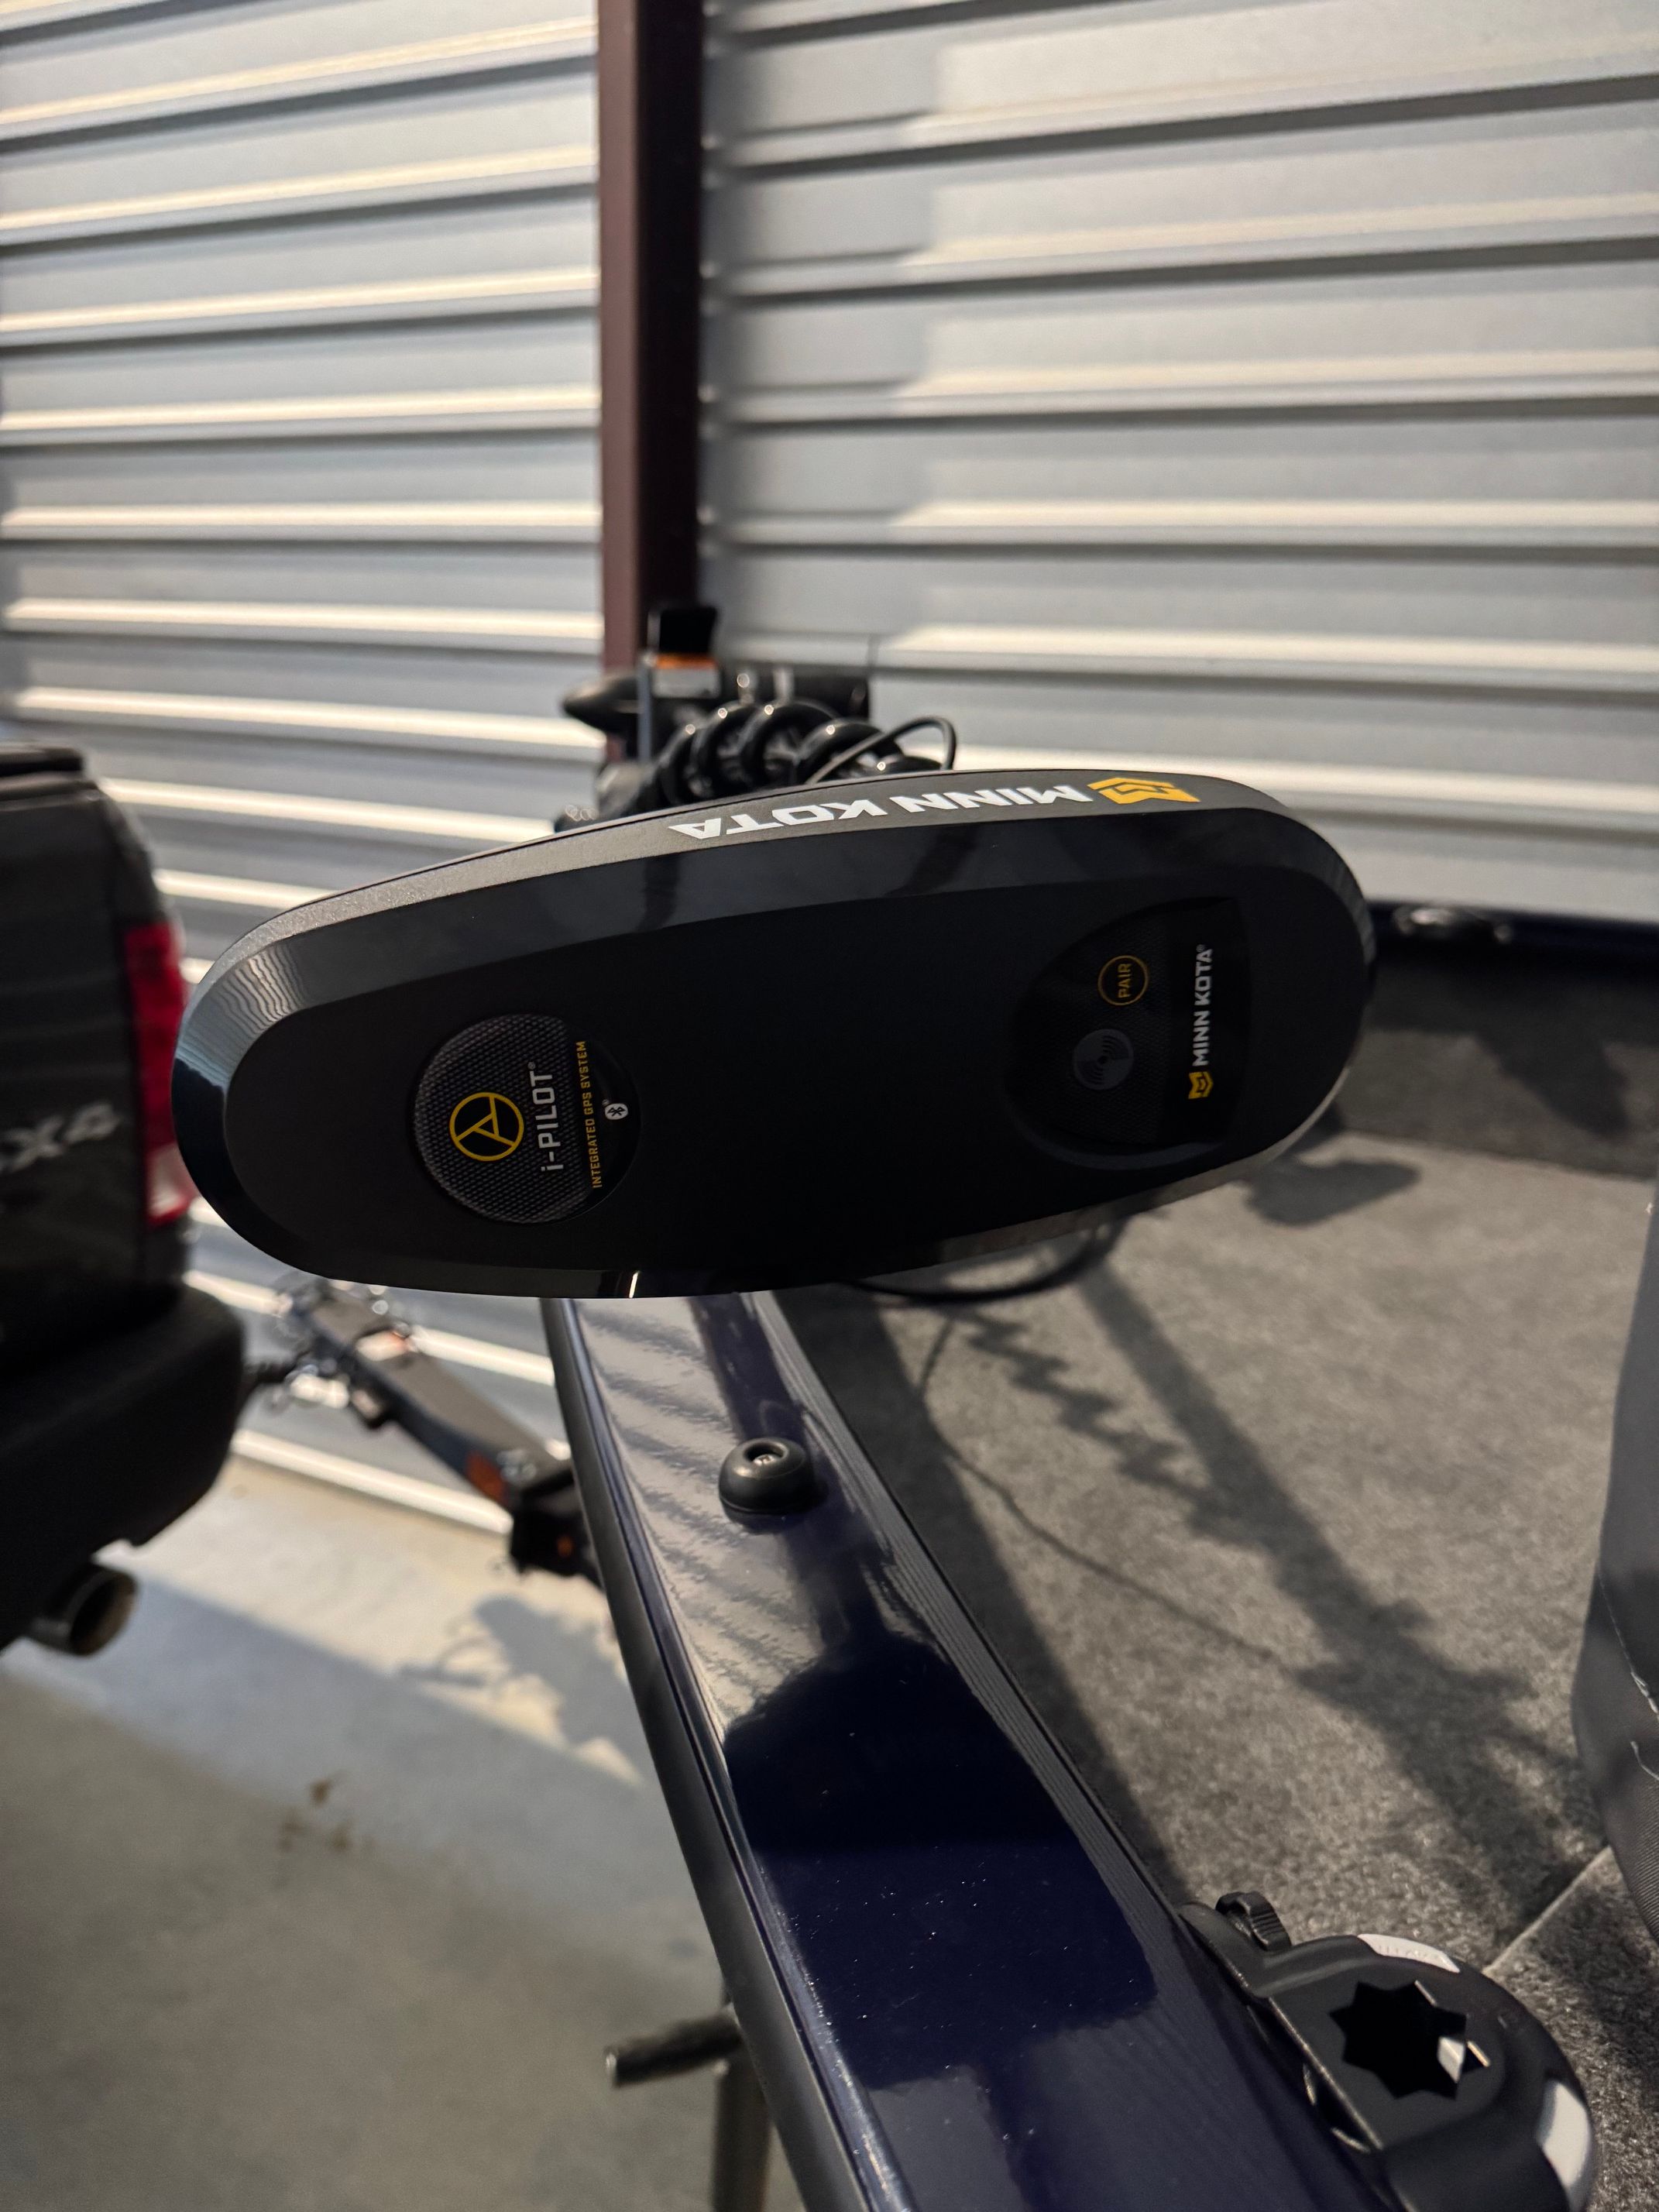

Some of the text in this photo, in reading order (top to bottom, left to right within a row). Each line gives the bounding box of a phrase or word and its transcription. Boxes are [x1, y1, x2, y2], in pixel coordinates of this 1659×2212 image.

[668, 783, 1095, 840] MINN KOTA
[1118, 963, 1132, 998] PAIR
[1193, 1010, 1211, 1067] MINN
[575, 1041, 603, 1190] INTEGRATED GPS SYSTEM
